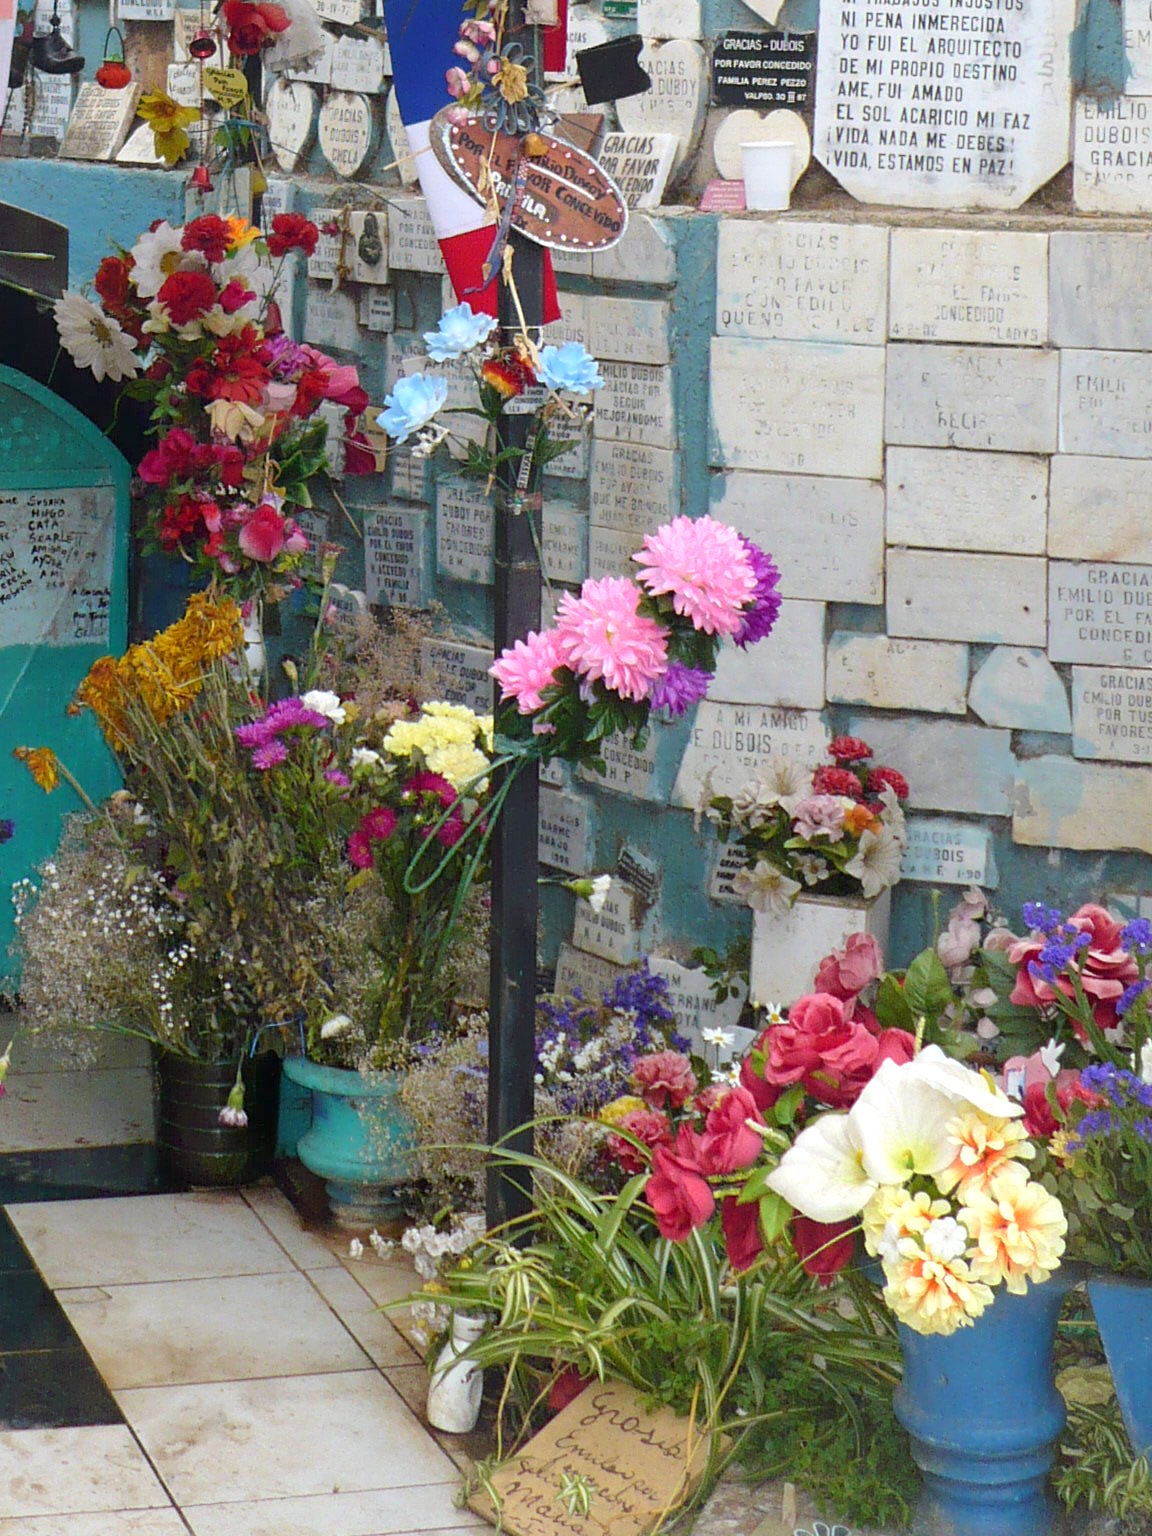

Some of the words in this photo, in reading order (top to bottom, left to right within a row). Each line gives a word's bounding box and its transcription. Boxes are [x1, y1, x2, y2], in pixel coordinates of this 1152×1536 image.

[841, 11, 856, 28] NI
[866, 12, 903, 29] PENA
[912, 14, 1005, 34] INMERECIDA
[723, 39, 762, 51] GRACIAS
[770, 40, 805, 52] DUBOIS
[841, 33, 859, 51] YO
[868, 35, 891, 52] FUI
[900, 36, 918, 53] EL
[927, 37, 1022, 59] ARQUITECTO
[715, 60, 734, 69] POR
[734, 60, 762, 69] FAVOR
[762, 60, 812, 70] CONCEDIDO
[840, 58, 858, 75] DE
[866, 58, 882, 76] MI
[890, 60, 944, 78] PROPIO
[953, 63, 1017, 82] DESTINO
[718, 76, 749, 85] FAMILIA
[752, 77, 778, 86] PEREZ
[877, 82, 901, 100] FUI
[912, 84, 963, 102] AMADO
[836, 104, 853, 121] EL
[862, 105, 891, 123] SOL
[900, 107, 968, 126] ACARICIO
[976, 110, 994, 128] MI
[1004, 112, 1031, 130] FAZ
[1084, 102, 1147, 120] EMILIO
[879, 128, 918, 147] NADA
[926, 130, 947, 149] ME
[1084, 126, 1151, 144] DUBOIS
[604, 136, 655, 154] GRACIAS
[621, 158, 660, 176] FAVOR
[877, 153, 944, 173] ESTAMOS
[952, 157, 971, 174] EN
[28, 520, 59, 530] CATA
[1058, 587, 1113, 604] EMILIO
[1065, 608, 1095, 622] POR
[1105, 610, 1124, 624] EL
[1083, 692, 1122, 707] EMILIO
[734, 710, 750, 726] MI
[1096, 708, 1121, 721] POR
[712, 730, 772, 754] DUBOIS
